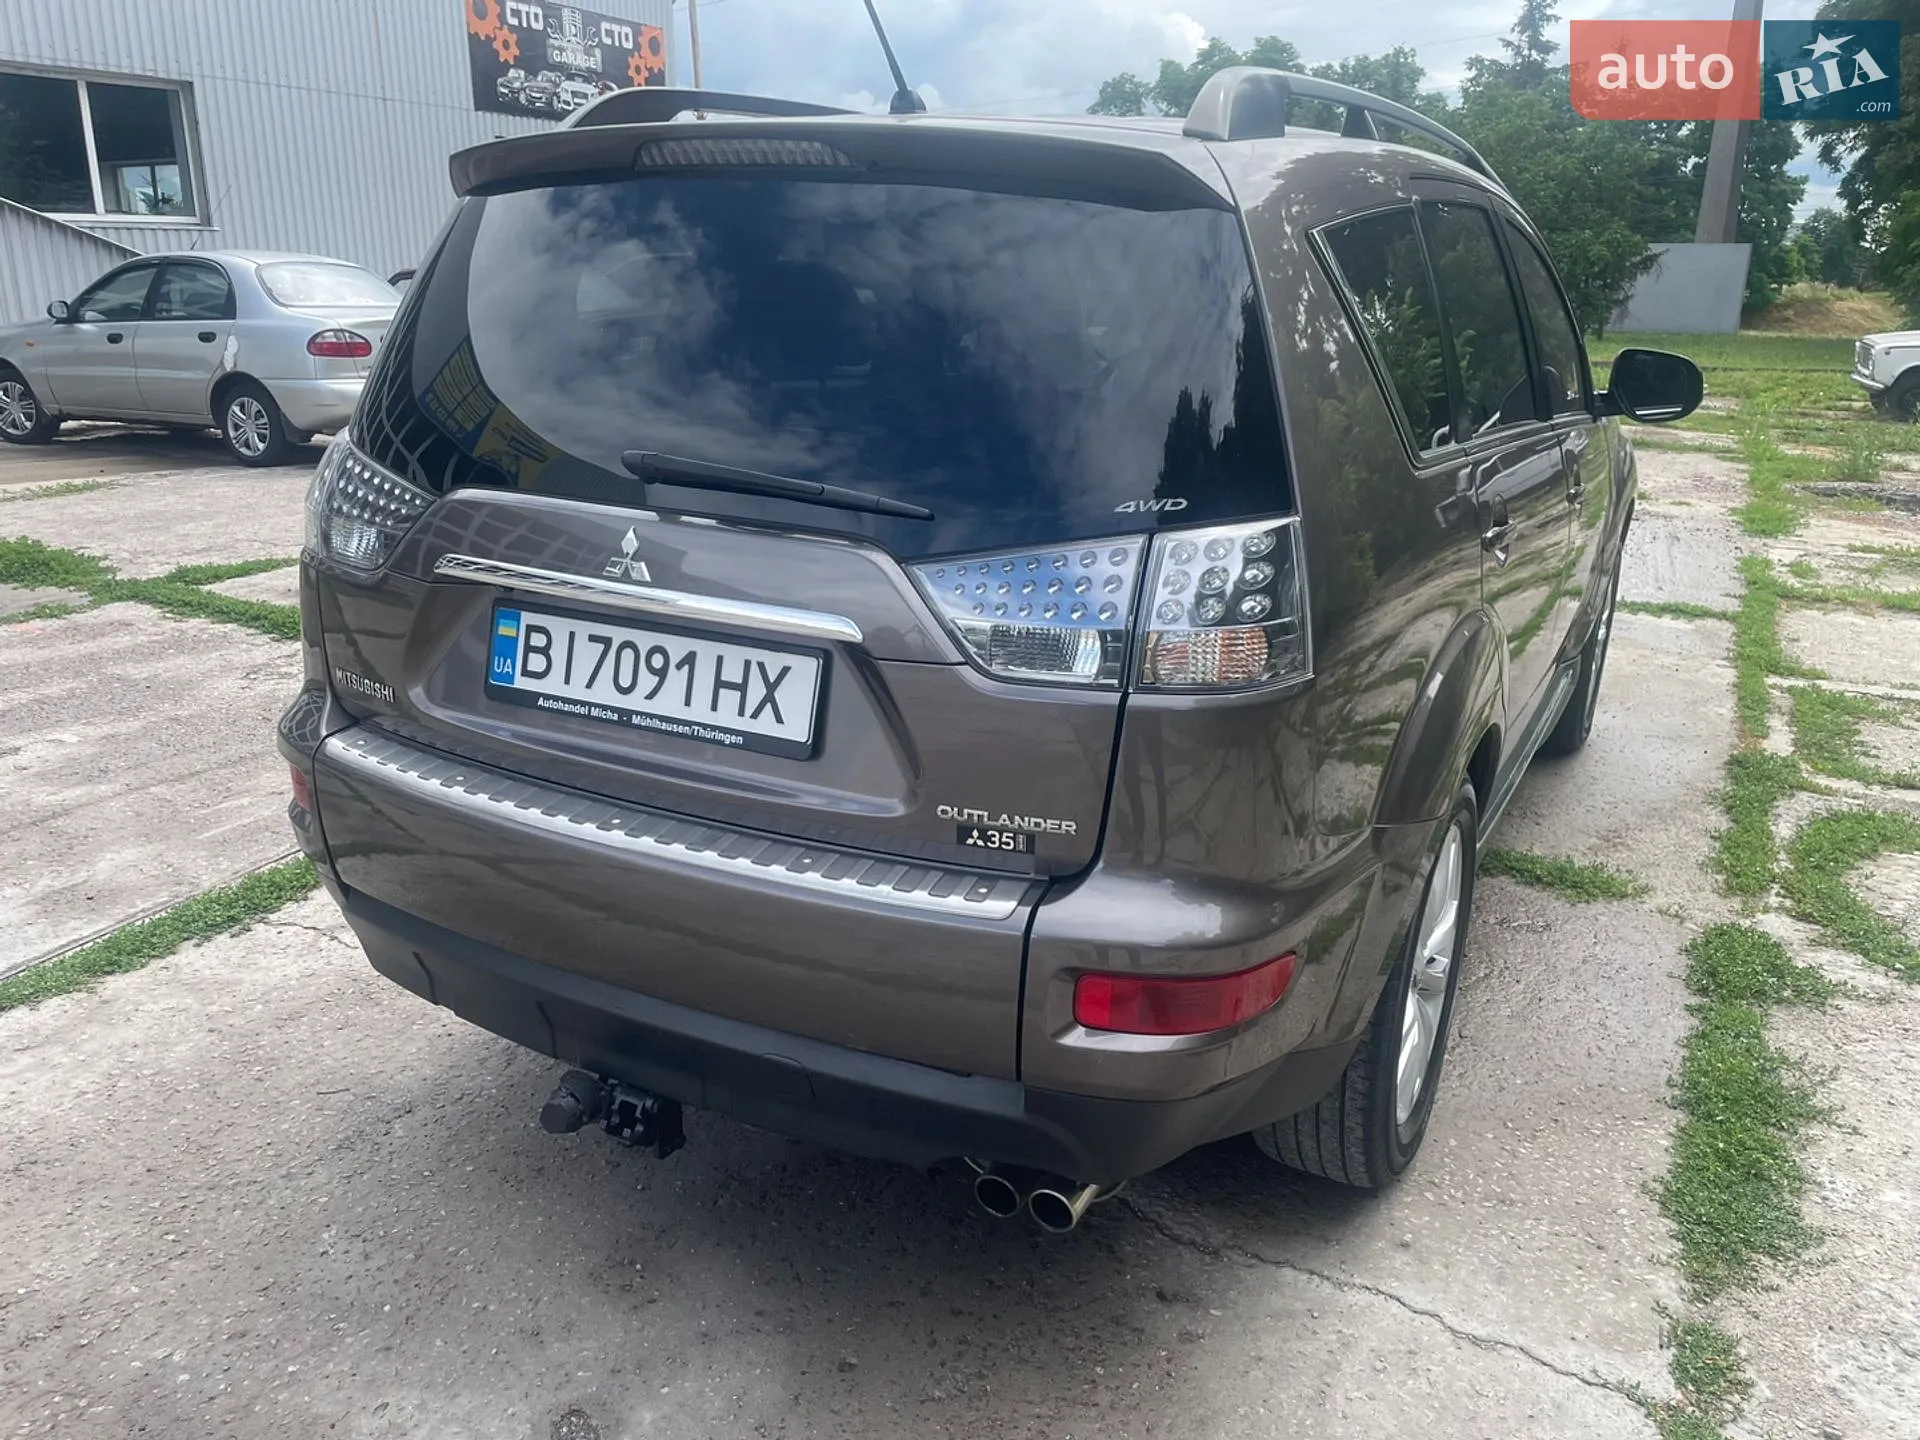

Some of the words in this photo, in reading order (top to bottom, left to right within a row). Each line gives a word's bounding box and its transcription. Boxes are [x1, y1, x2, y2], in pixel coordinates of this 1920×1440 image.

[506, 1, 544, 31] СТО
[601, 21, 633, 49] СТО
[553, 49, 598, 69] GARAGE
[1113, 498, 1188, 513] 4WD
[493, 656, 514, 675] UA
[335, 666, 395, 703] MITSUBISHI
[537, 696, 589, 716] Autohandel
[590, 706, 619, 721] Micha
[936, 804, 1077, 836] OUTLANDER
